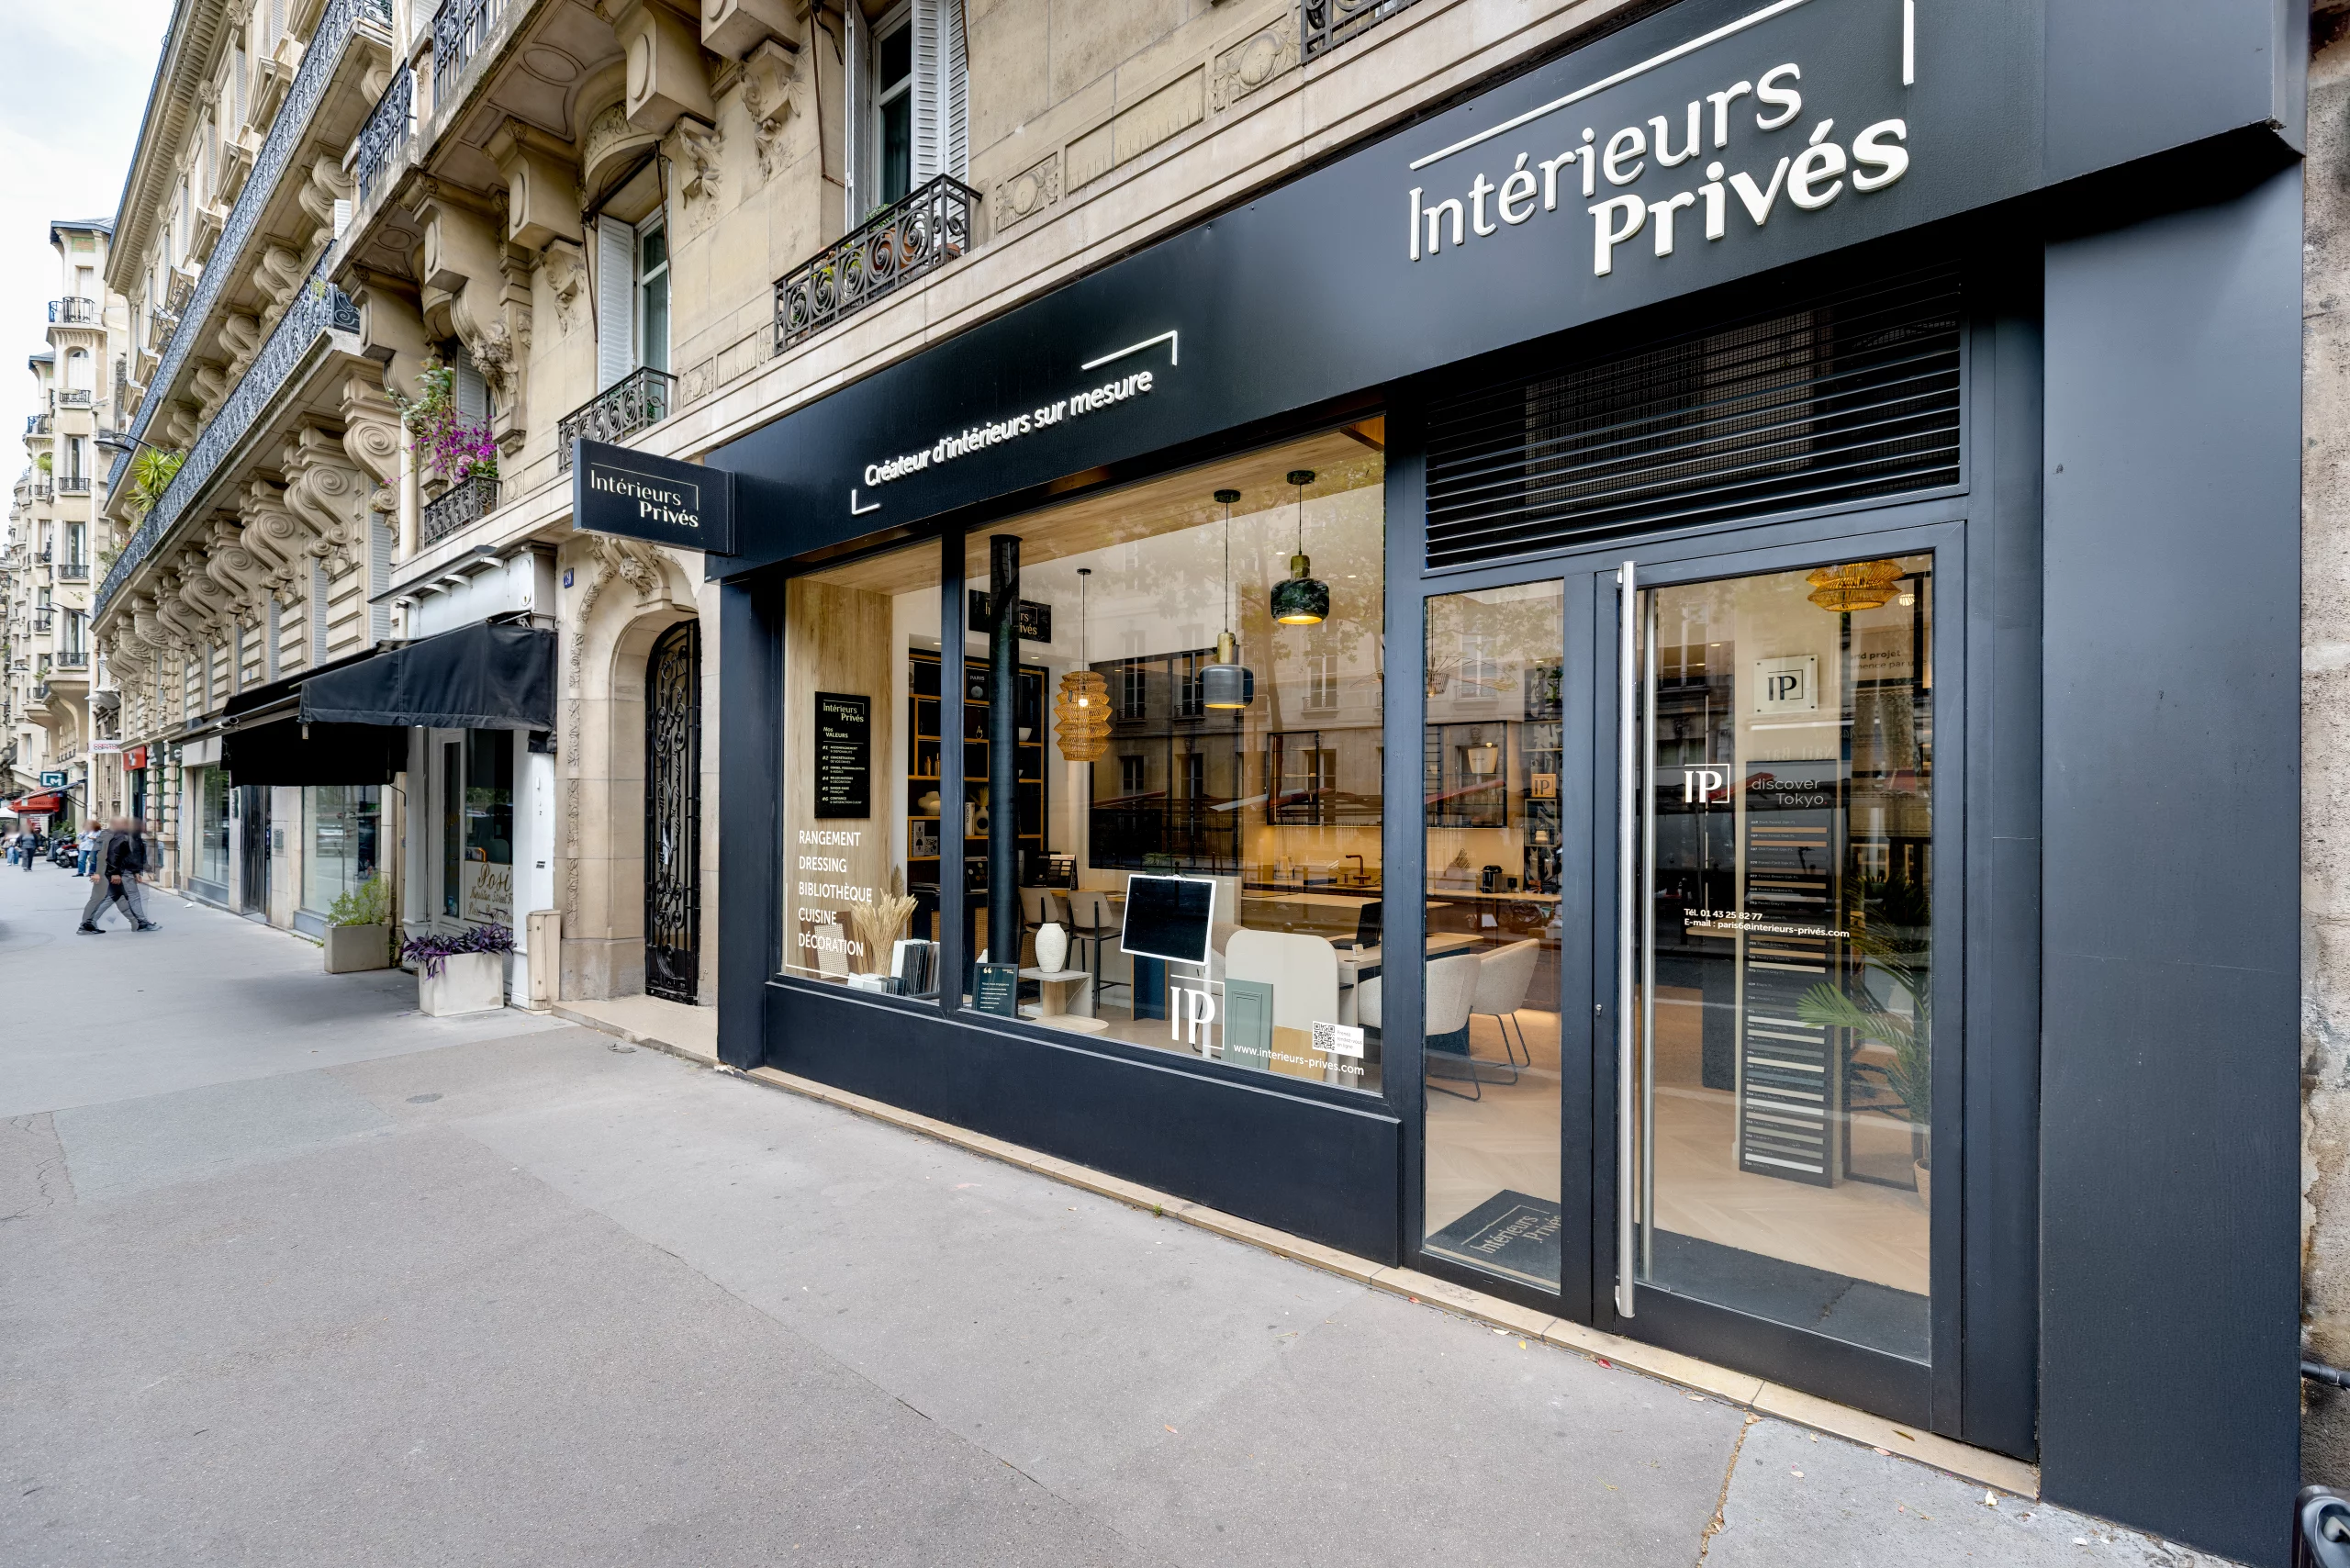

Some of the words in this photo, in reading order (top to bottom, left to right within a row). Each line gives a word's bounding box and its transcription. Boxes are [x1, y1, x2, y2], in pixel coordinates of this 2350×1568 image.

[1408, 62, 1803, 262] Intérieurs
[1588, 118, 1909, 275] Privés
[865, 449, 931, 487] Créateur
[933, 413, 1031, 464] d'intérieurs
[1035, 399, 1067, 429] sur
[1070, 371, 1153, 416] mesure
[590, 469, 682, 506] Intérieurs
[639, 499, 699, 528] Privés
[1869, 649, 1901, 661] projet
[1889, 661, 1905, 670] par
[1767, 676, 1797, 701] IP
[823, 702, 857, 713] Intérieurs
[841, 712, 865, 722] Privés
[1534, 779, 1550, 795] IP
[1684, 770, 1723, 803] IP
[1751, 778, 1821, 790] discover
[799, 830, 861, 846] RANGEMENT
[799, 856, 847, 873] DRESSING
[799, 881, 873, 902] BIBLIOTHÈQUE
[798, 907, 837, 924] CUISINE
[1684, 908, 1698, 917] Tél.
[1700, 909, 1711, 917] 01
[1713, 910, 1724, 918] 43
[1725, 911, 1737, 919] 25
[1739, 912, 1751, 920] 82
[1751, 913, 1762, 921] 77
[1684, 918, 1711, 927] E-mail
[1718, 921, 1850, 938] paris6@interieurs-privés.com
[798, 931, 864, 958] DÉCORATION
[1170, 986, 1216, 1045] IP
[1233, 1044, 1364, 1076] www.interieurs-prives.com
[1470, 1215, 1539, 1254] Intérieurs
